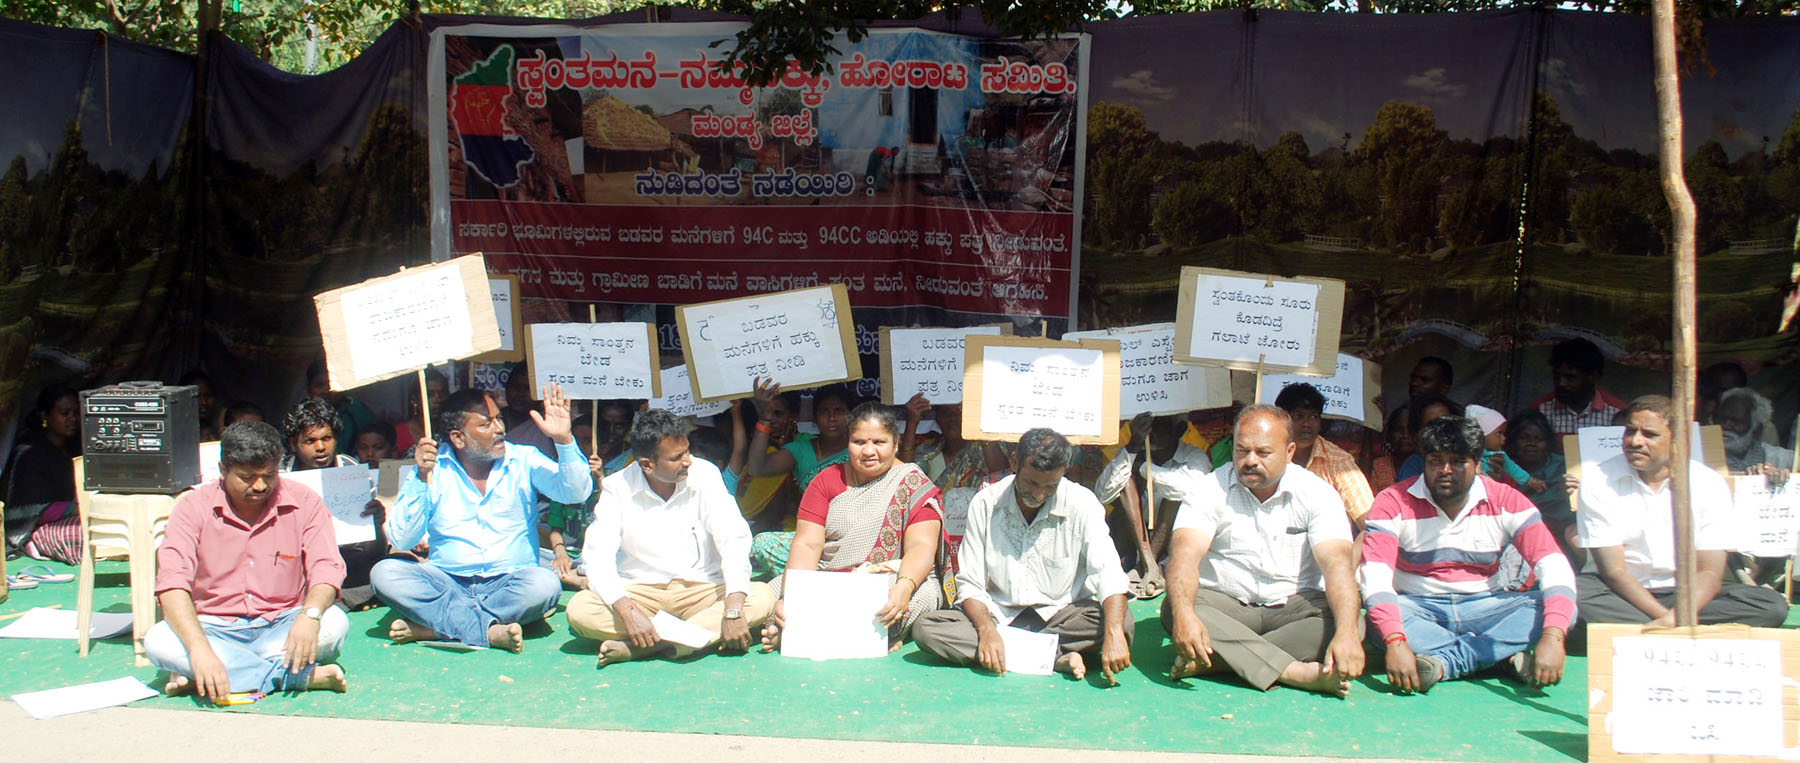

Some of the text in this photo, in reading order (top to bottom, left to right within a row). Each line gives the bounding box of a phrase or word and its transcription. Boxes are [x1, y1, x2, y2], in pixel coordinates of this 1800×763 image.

[840, 54, 967, 89] ಹೋರಾಟ
[981, 56, 1076, 95] ಸಮಿತಿ.
[692, 108, 818, 150] ಮಂಡ್ಯ ಜಿಲ್ಲೆ.
[635, 167, 742, 199] ನುಡಿದಂತೆ
[753, 166, 856, 197] ನಡೆಯಿರಿ
[459, 221, 508, 238] ಸರ್ಕಾರಿ
[618, 226, 663, 243] ಬಡವರ
[670, 225, 735, 245] ಮನೆಗಳಿಗೆ
[743, 226, 773, 244] 94C
[778, 231, 808, 249] ಮತ್ತು
[819, 226, 862, 245] 94CC
[924, 230, 953, 256] ಹಕ್ಕು
[549, 267, 585, 293] ಮತ್ತು
[706, 271, 738, 291] ಮನೆ
[1280, 297, 1311, 311] ಸೂರು
[741, 313, 789, 333] ಬಡವರ
[557, 335, 635, 354] ನಿಮ್ಮ ಸಾಂತ್ವನ
[723, 330, 821, 359] ಮನೆಗಳಿಗೆ ಹಕ್ಕು
[1211, 330, 1301, 350] ಗಲಾಟೆ ಜೋರು
[580, 353, 611, 366] ಬೇಡ
[776, 354, 805, 372] ನೀಡಿ
[900, 356, 957, 372] ಮನೆಗಳಿಗೆ
[582, 375, 608, 386] ಮನೆ
[615, 376, 645, 388] ಬೇಕು
